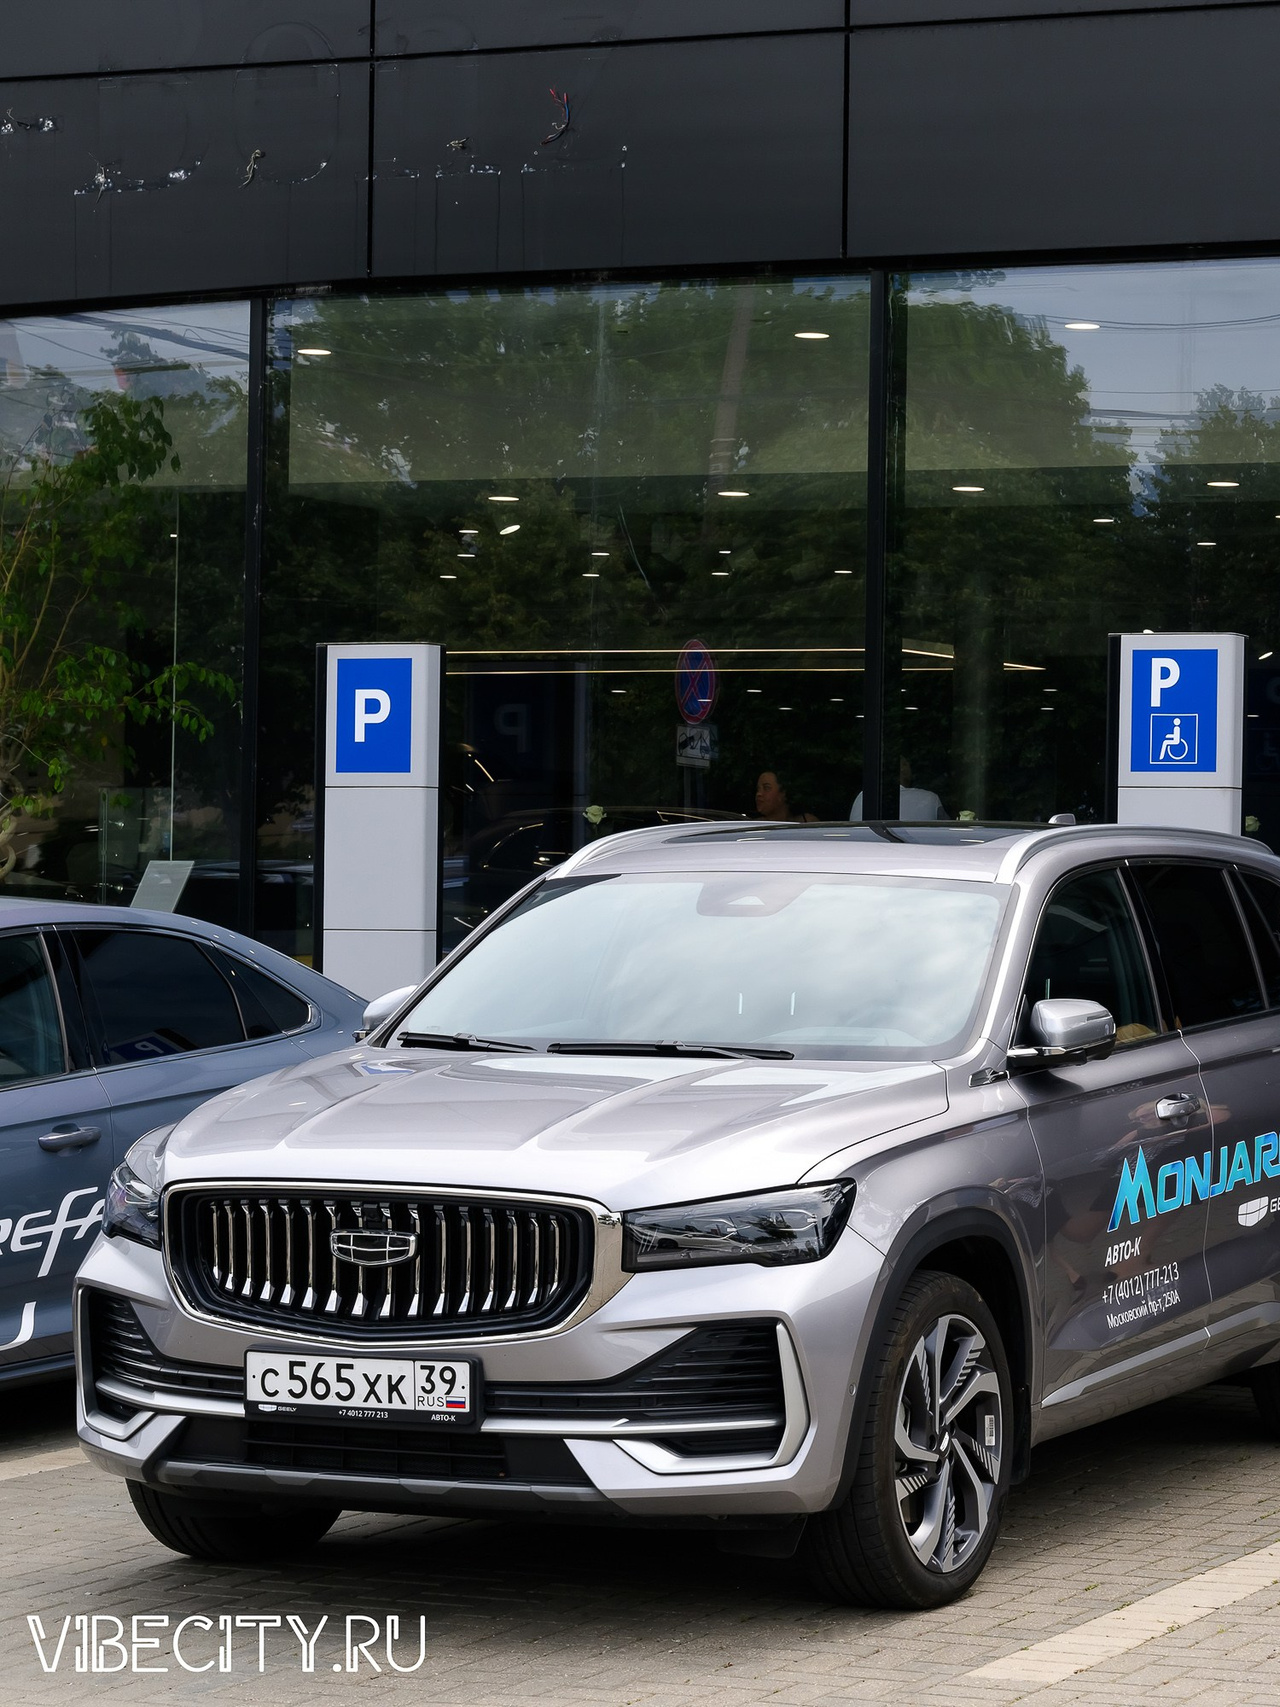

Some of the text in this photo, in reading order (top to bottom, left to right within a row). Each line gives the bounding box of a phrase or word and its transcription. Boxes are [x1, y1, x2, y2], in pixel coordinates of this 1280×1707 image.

[1150, 657, 1181, 708] P
[353, 688, 391, 743] P
[1104, 1236, 1142, 1267] АВТО-К
[1144, 1262, 1180, 1291] 777-213
[1106, 1299, 1149, 1329] Московский
[420, 1365, 457, 1395] 39
[347, 1410, 363, 1418] 4012
[417, 1395, 445, 1408] RUS
[430, 1413, 456, 1422] АВТО-К
